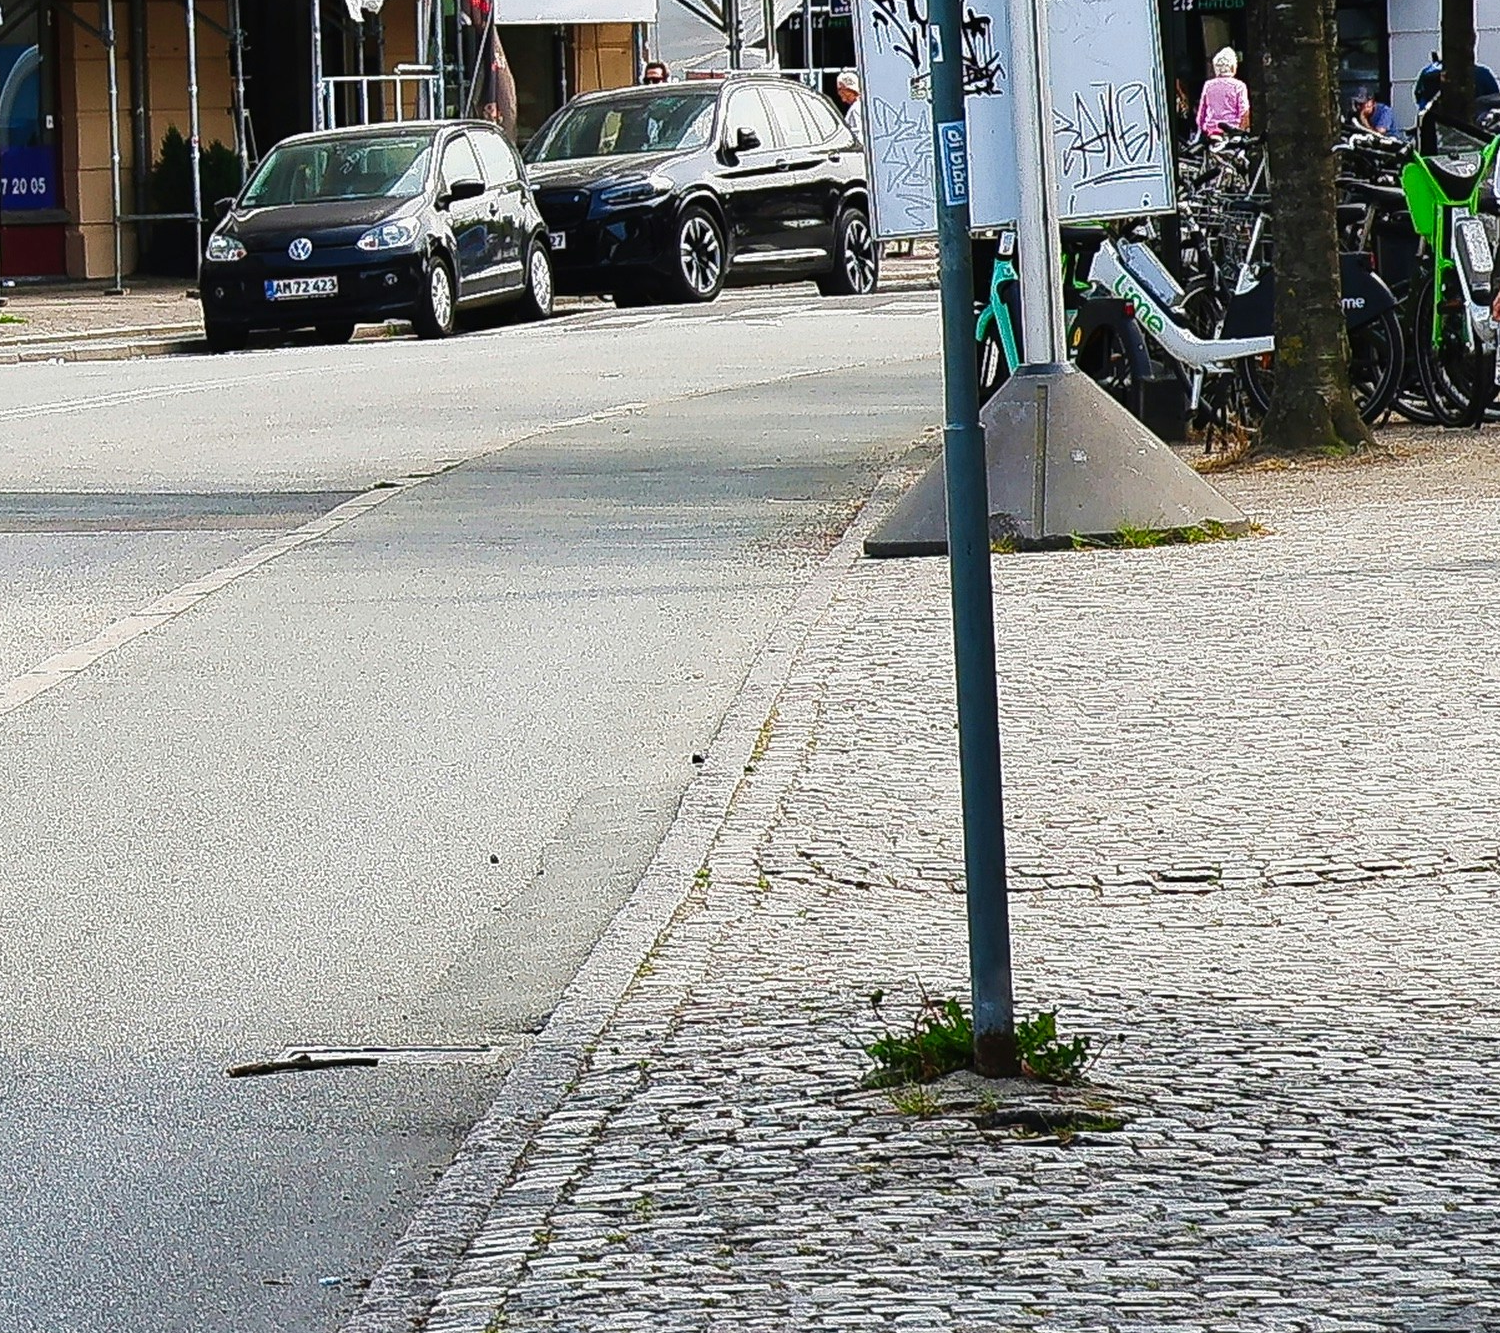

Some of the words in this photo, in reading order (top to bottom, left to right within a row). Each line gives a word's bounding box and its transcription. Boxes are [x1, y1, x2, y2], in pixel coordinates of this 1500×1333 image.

[12, 177, 28, 195] 20
[30, 176, 46, 195] 05
[274, 281, 293, 295] AM
[293, 280, 311, 294] 72
[313, 278, 337, 292] 423
[1114, 273, 1164, 336] Lime
[1340, 297, 1366, 309] me
